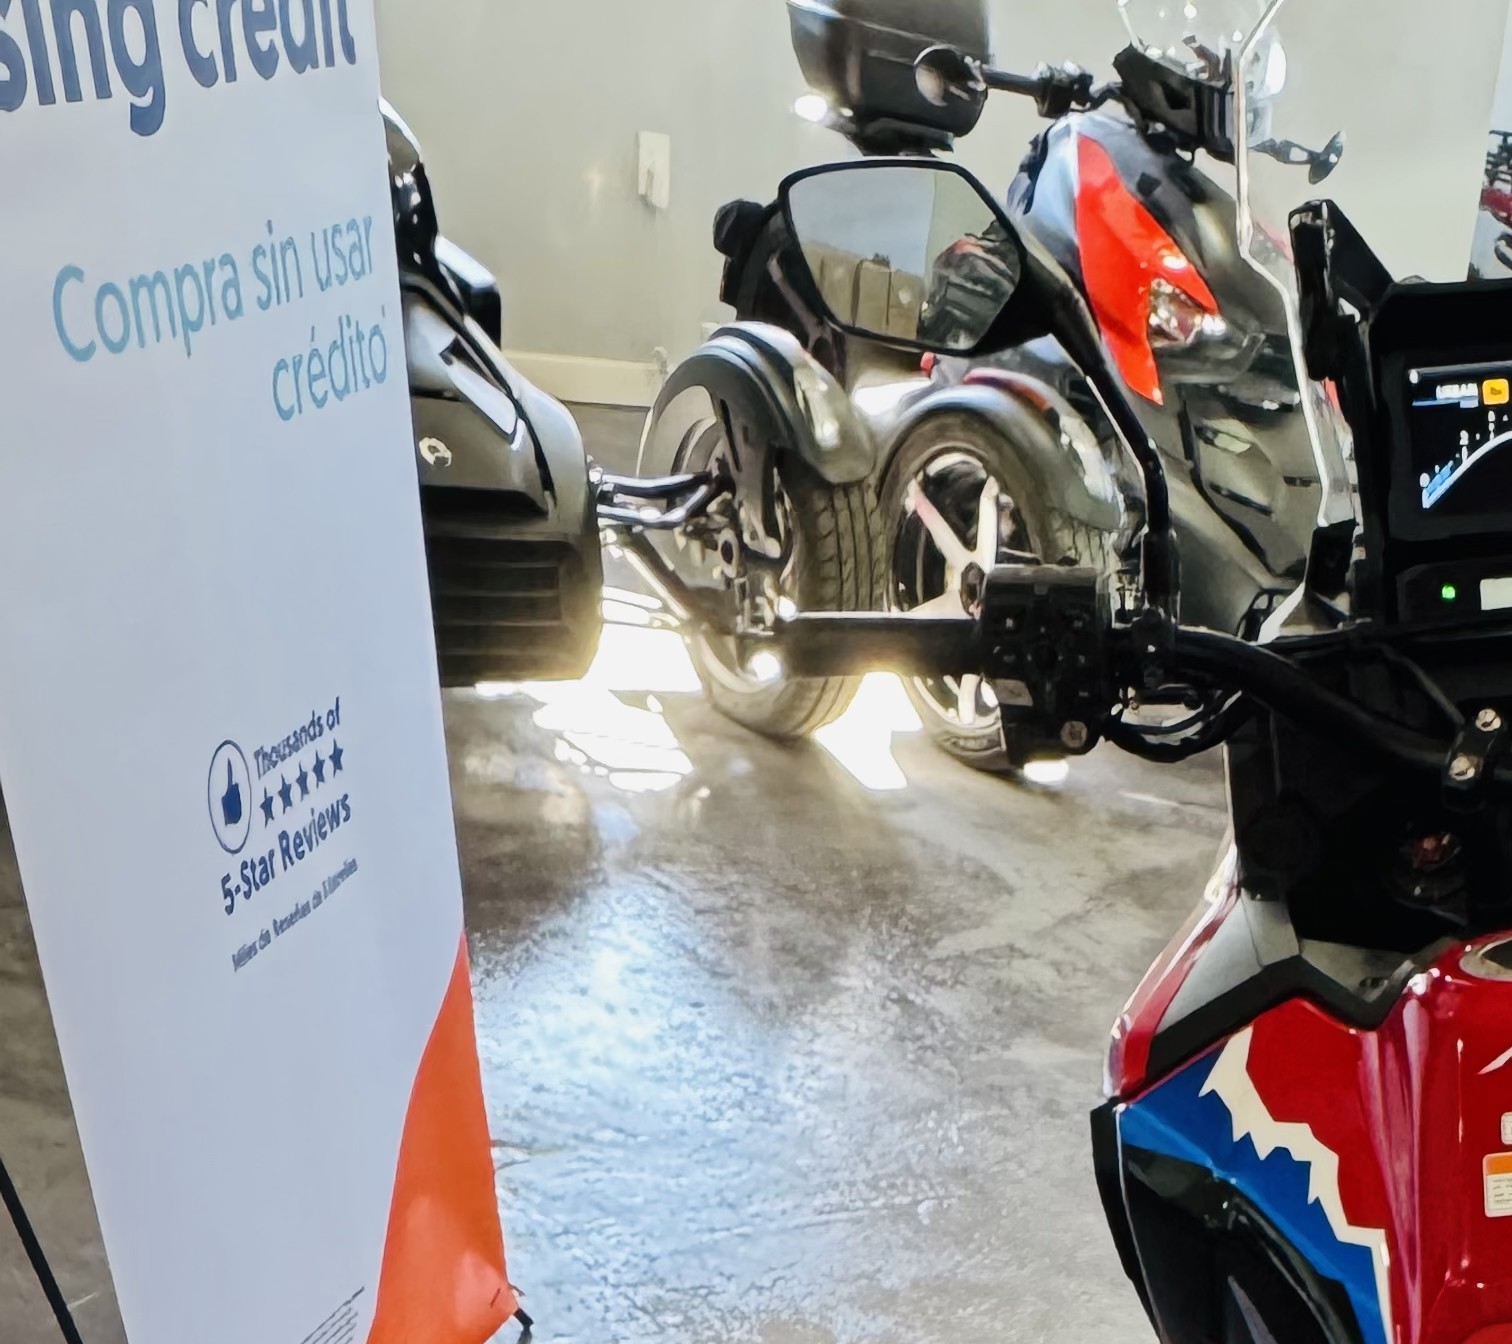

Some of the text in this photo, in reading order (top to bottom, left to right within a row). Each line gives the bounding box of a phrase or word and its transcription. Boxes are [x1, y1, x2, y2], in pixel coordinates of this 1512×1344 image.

[52, 215, 373, 362] Compra sin usar
[253, 709, 324, 781] Thousands
[220, 848, 275, 916] 5-Star
[277, 793, 351, 872] Reviews
